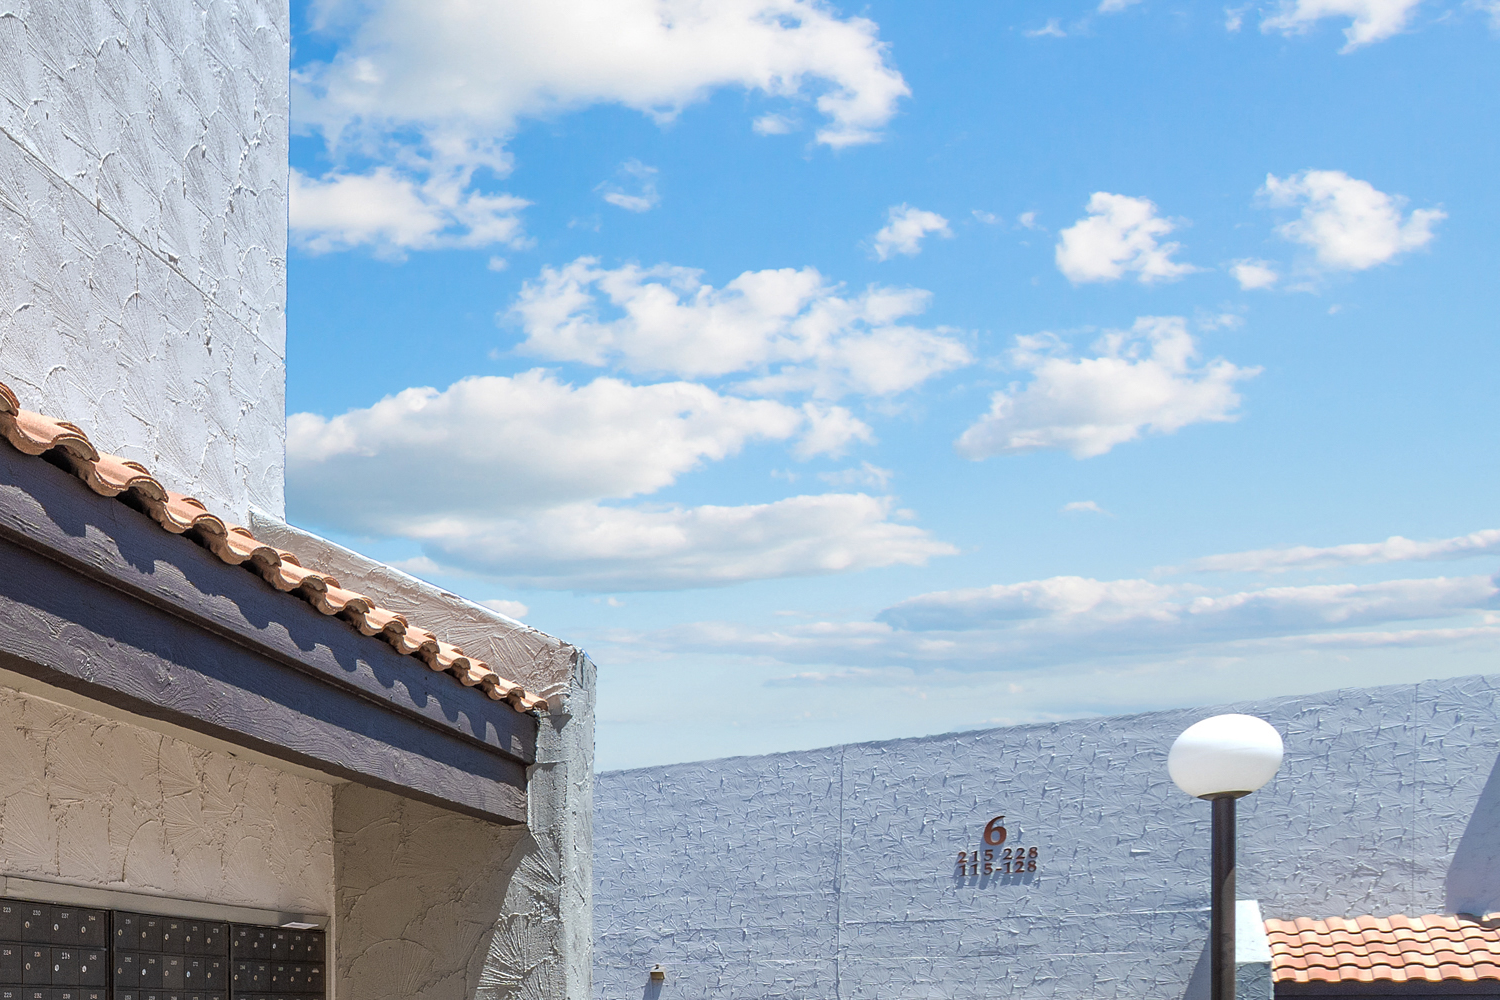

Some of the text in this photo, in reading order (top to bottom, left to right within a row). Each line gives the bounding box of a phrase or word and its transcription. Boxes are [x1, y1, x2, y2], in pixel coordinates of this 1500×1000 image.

[983, 815, 1007, 846] 6
[957, 846, 1039, 864] 215 228
[958, 860, 1037, 877] 115-128
